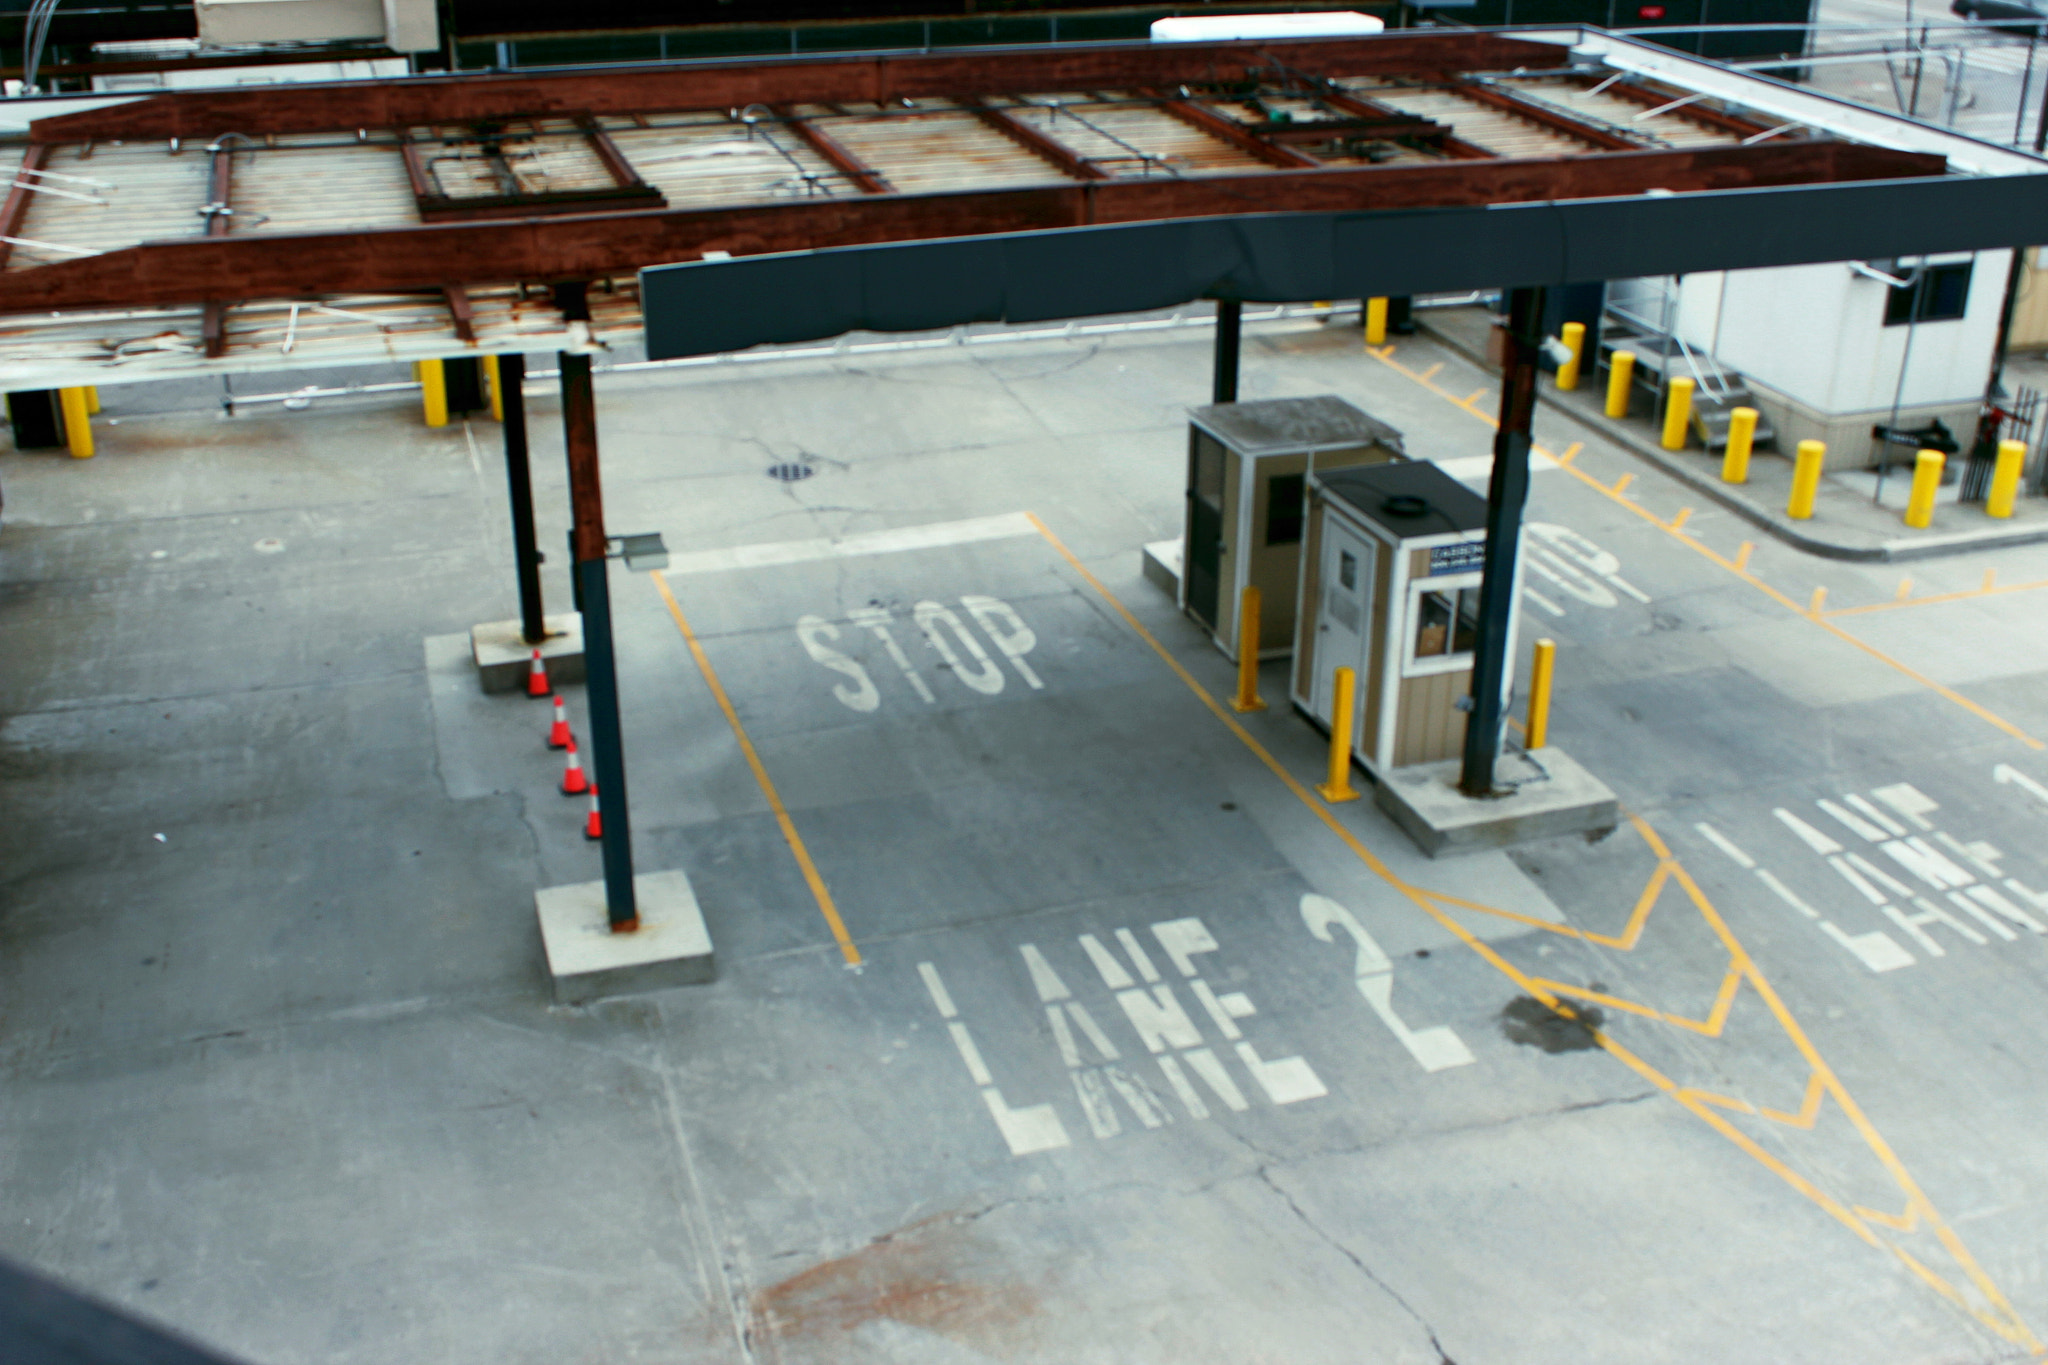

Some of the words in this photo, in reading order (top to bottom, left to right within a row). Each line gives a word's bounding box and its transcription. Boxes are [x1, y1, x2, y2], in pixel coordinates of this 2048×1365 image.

[797, 594, 1045, 712] STOP
[1695, 782, 2048, 973] LANE
[917, 917, 1328, 1155] LANE
[1298, 893, 1477, 1073] 2
